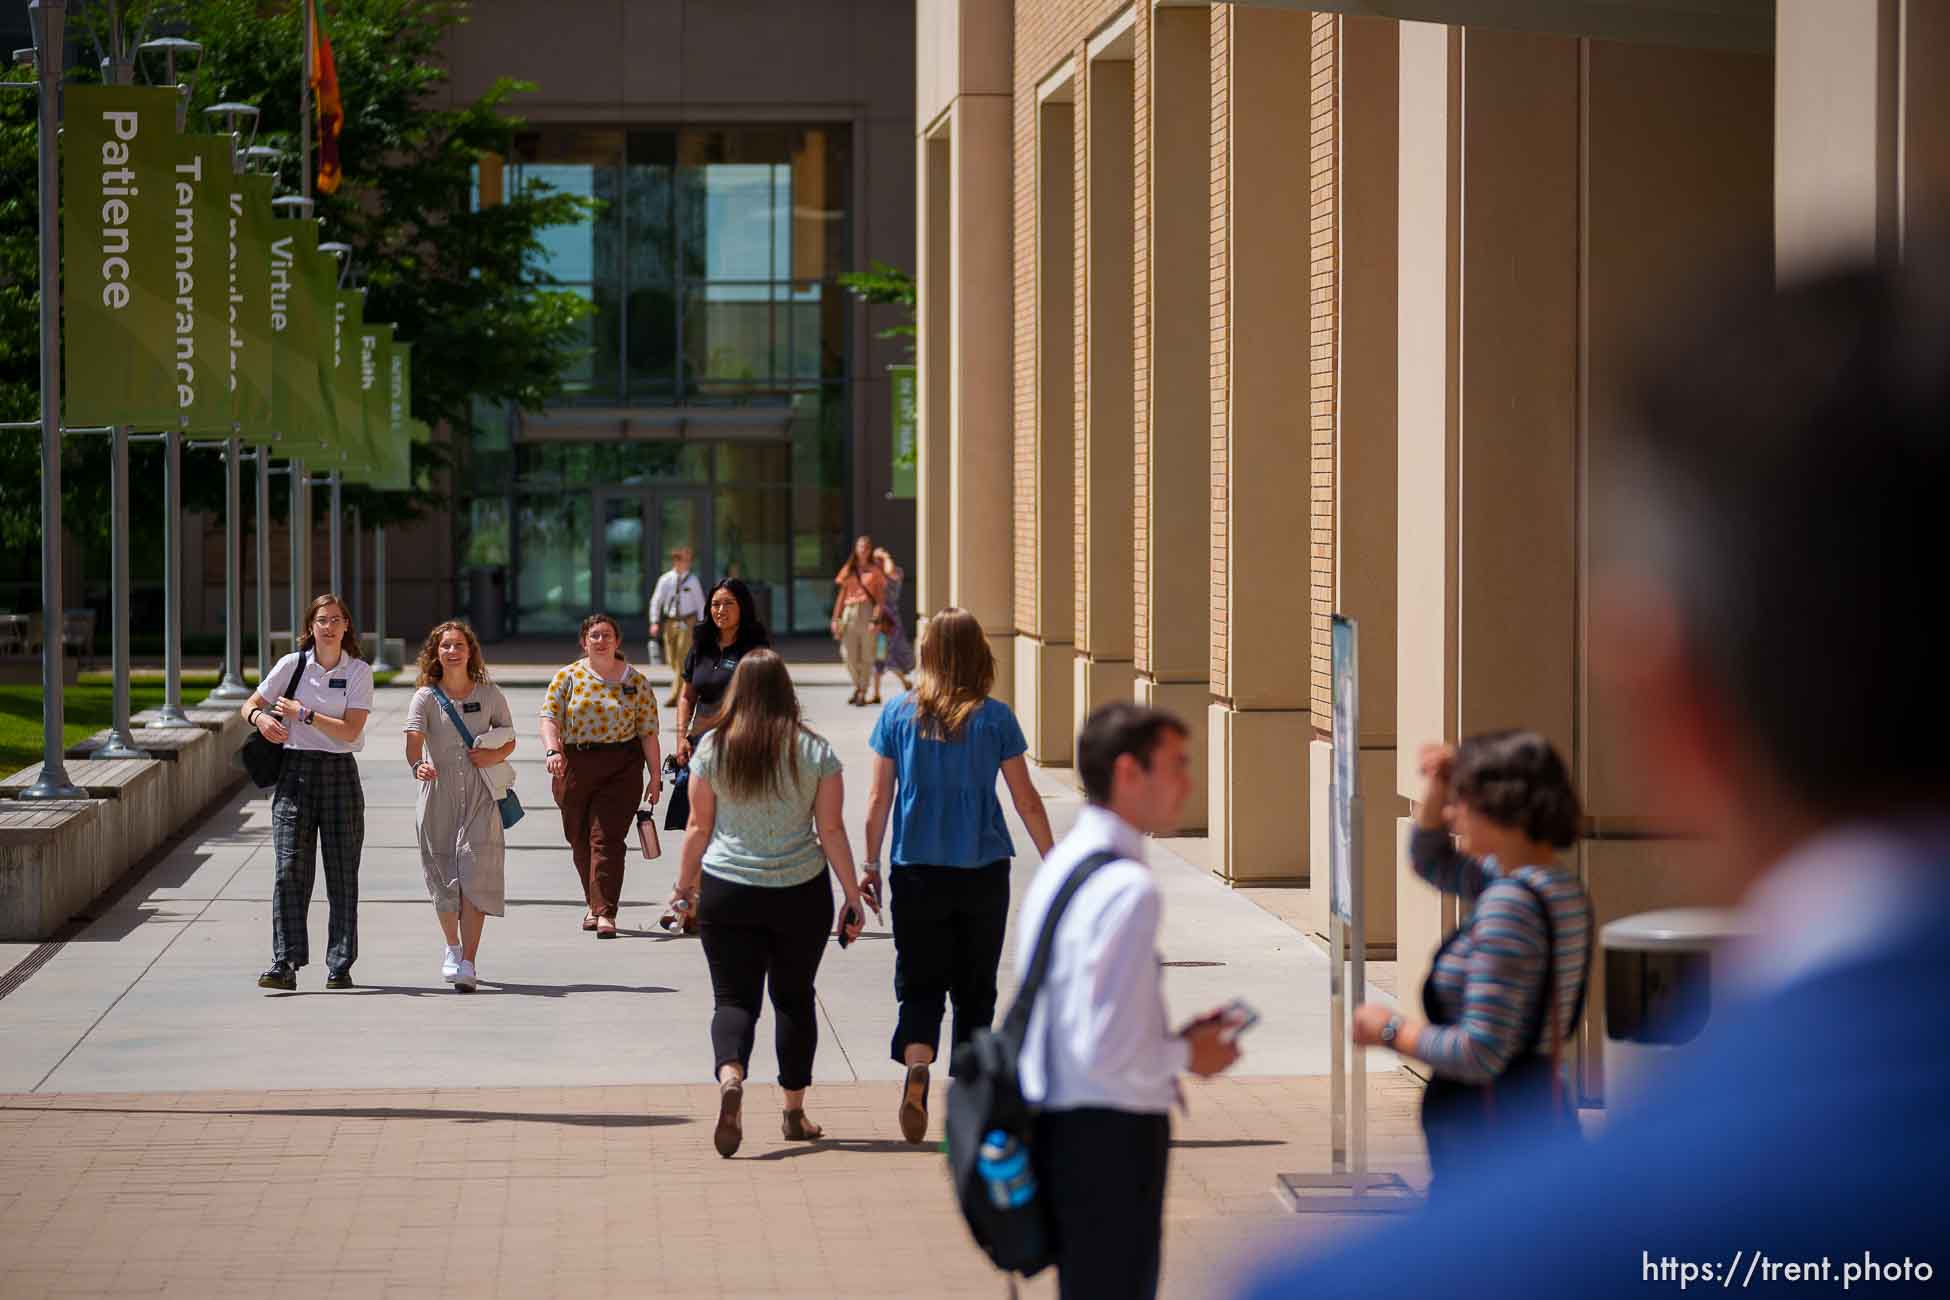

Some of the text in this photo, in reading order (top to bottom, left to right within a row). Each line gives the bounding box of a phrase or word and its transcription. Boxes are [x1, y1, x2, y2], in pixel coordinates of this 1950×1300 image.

[101, 111, 139, 309] Patience
[175, 156, 201, 408] Temperance
[271, 236, 294, 332] Virtue
